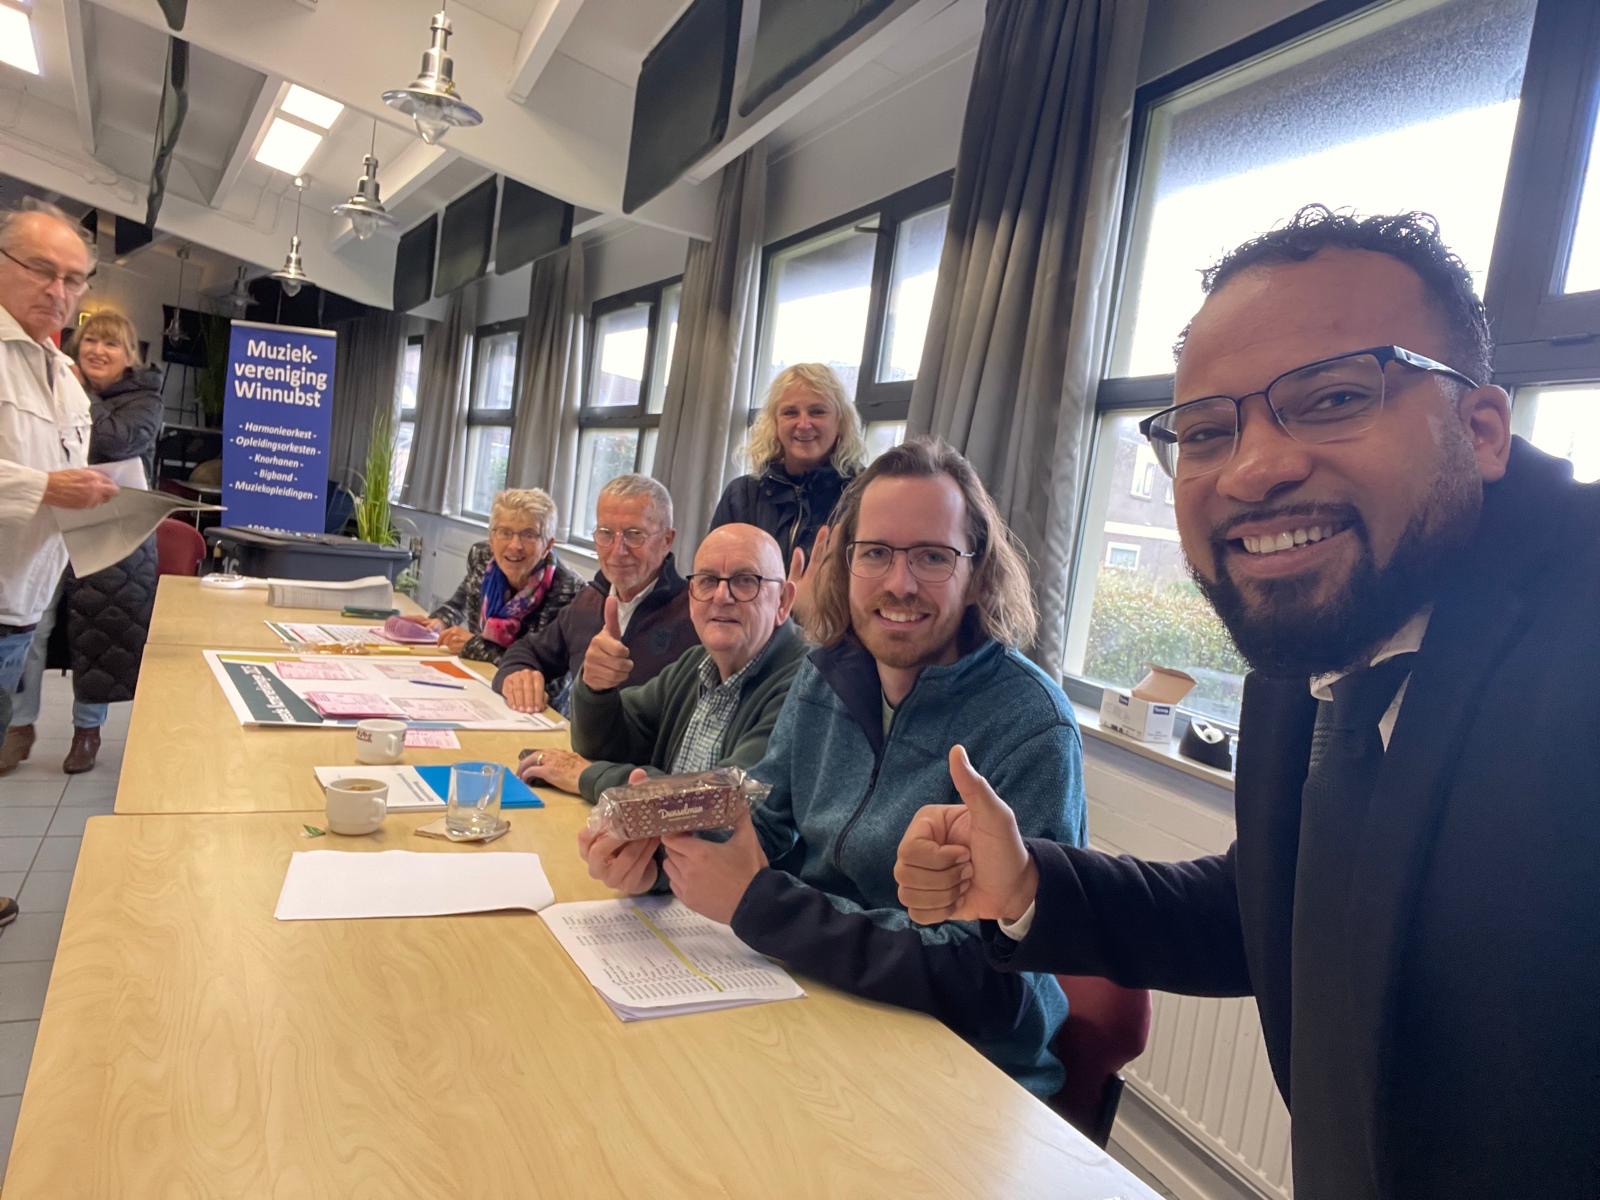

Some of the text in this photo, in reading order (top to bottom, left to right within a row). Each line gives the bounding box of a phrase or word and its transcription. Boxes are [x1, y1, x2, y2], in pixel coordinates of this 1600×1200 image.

[247, 339, 318, 364] Muziek-
[234, 362, 328, 391] vereniging
[234, 380, 321, 408] Winnubst
[245, 422, 312, 440] Harmonieorkest
[235, 436, 316, 456] Opleidingsorkesten
[254, 453, 299, 468] Knorhanen
[259, 469, 294, 482] Bigband
[234, 480, 313, 500] Muziekopleidingen
